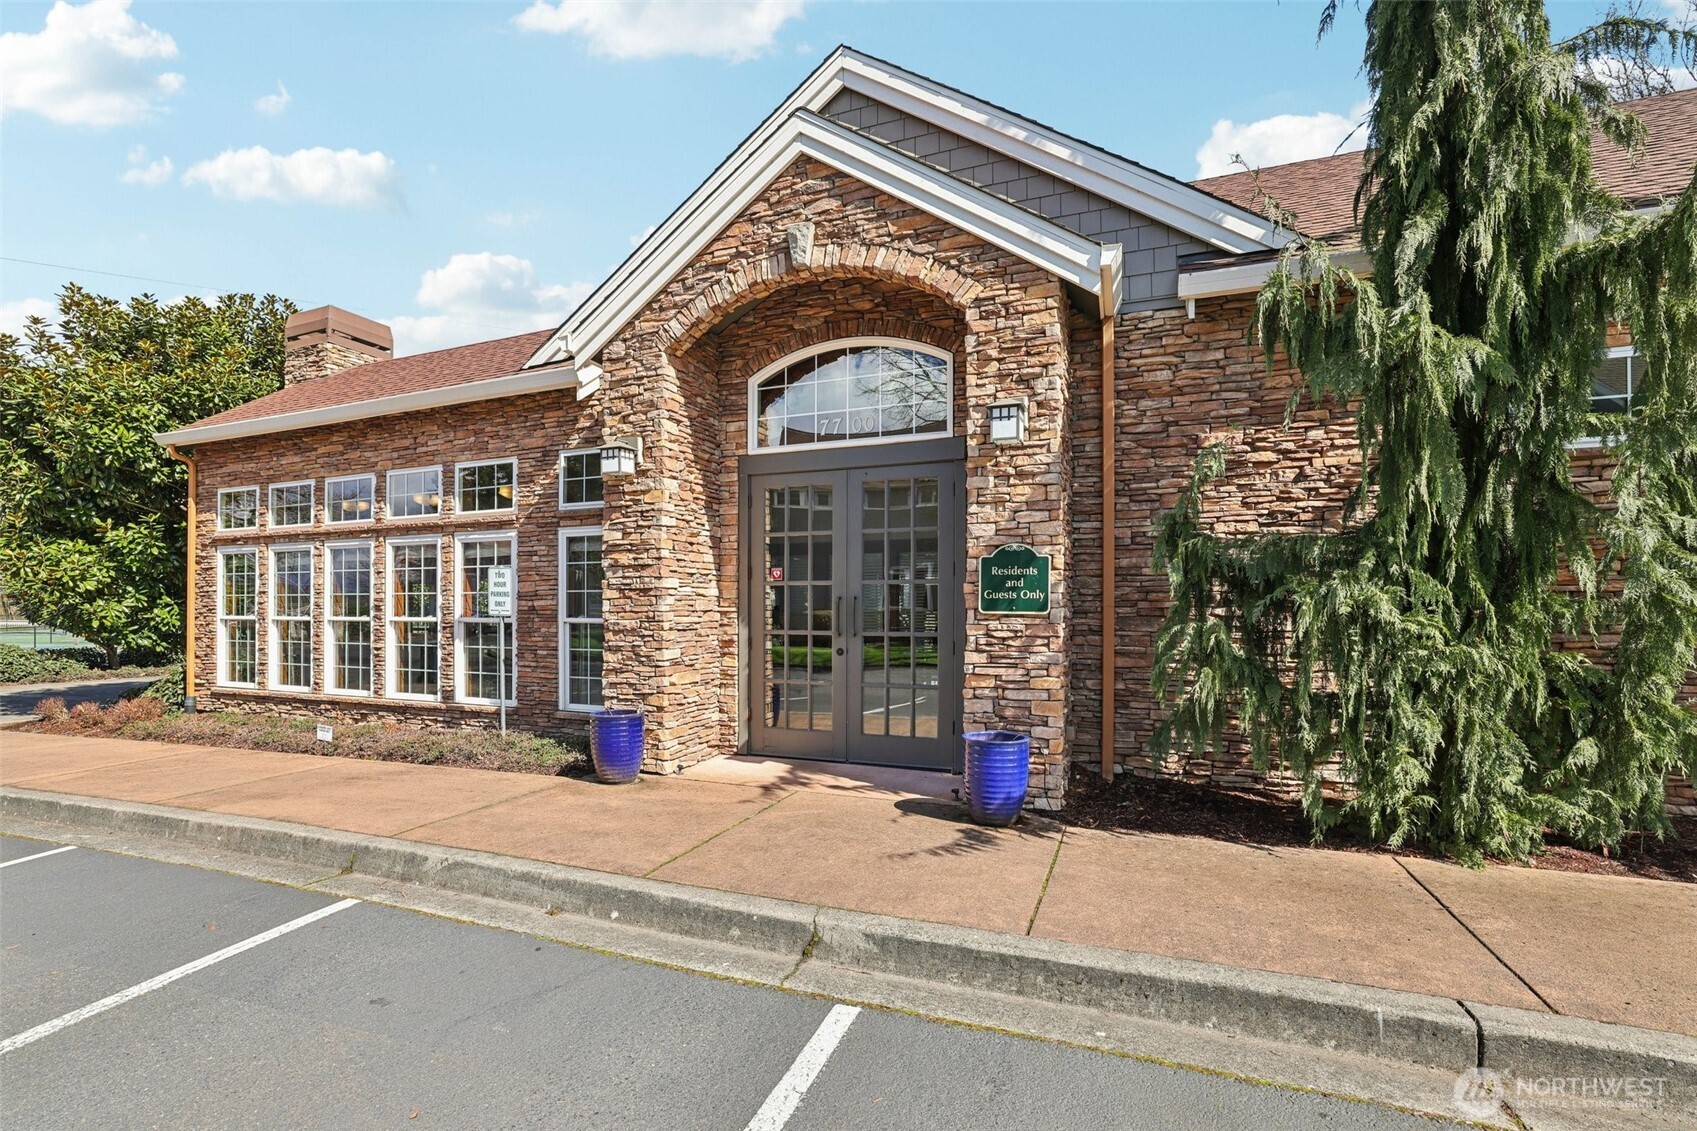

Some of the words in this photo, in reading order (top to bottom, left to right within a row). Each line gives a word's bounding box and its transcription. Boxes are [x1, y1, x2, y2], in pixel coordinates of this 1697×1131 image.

[991, 566, 1038, 575] Residents
[1005, 577, 1024, 587] and
[984, 589, 1017, 599] Guests
[1020, 589, 1045, 602] Only
